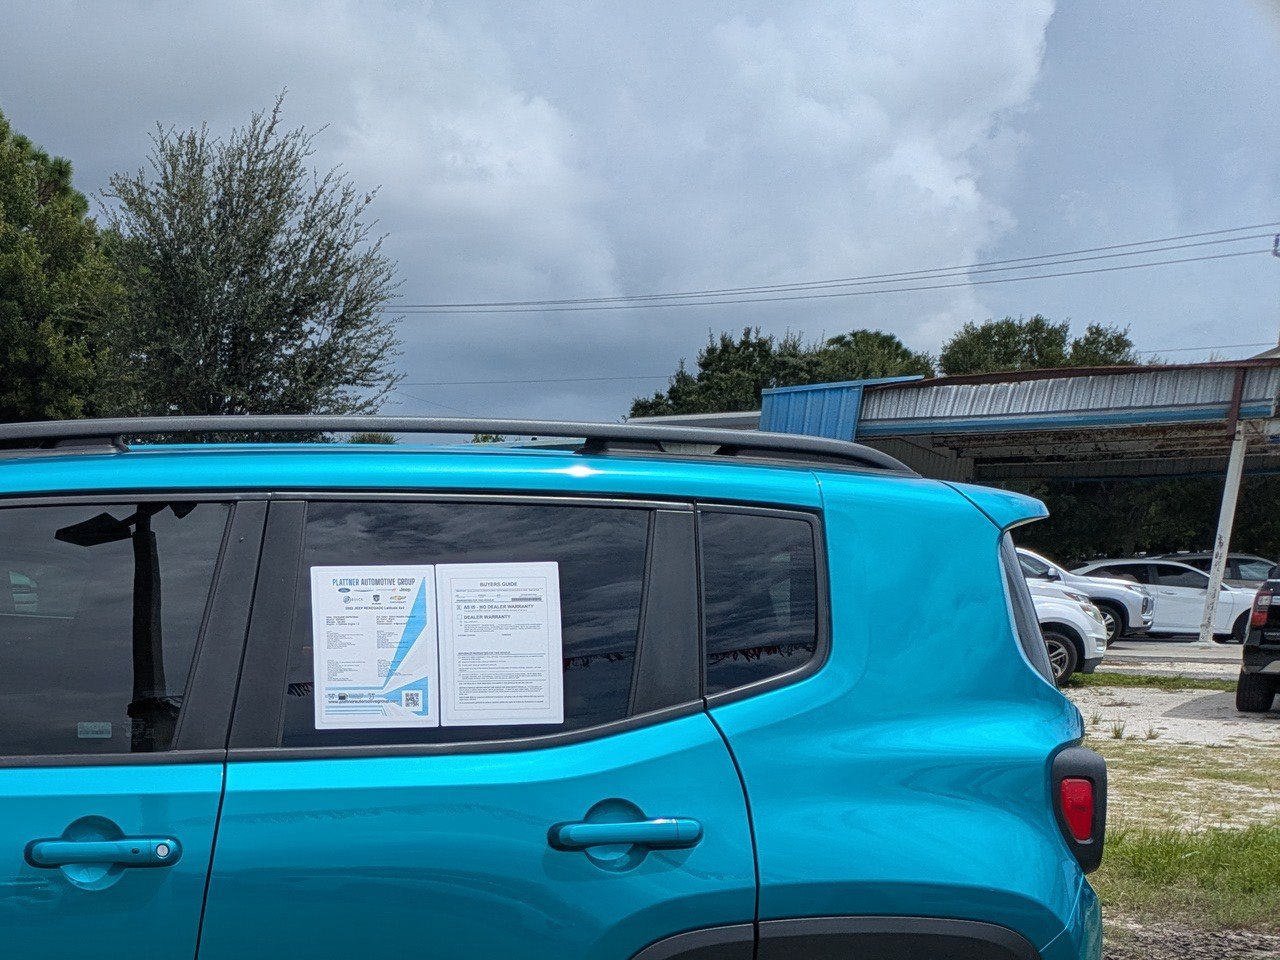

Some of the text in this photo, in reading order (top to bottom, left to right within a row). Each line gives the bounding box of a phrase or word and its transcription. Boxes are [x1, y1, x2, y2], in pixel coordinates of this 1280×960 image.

[332, 578, 416, 586] PLATTNER AUTOMOTIVE GROUP
